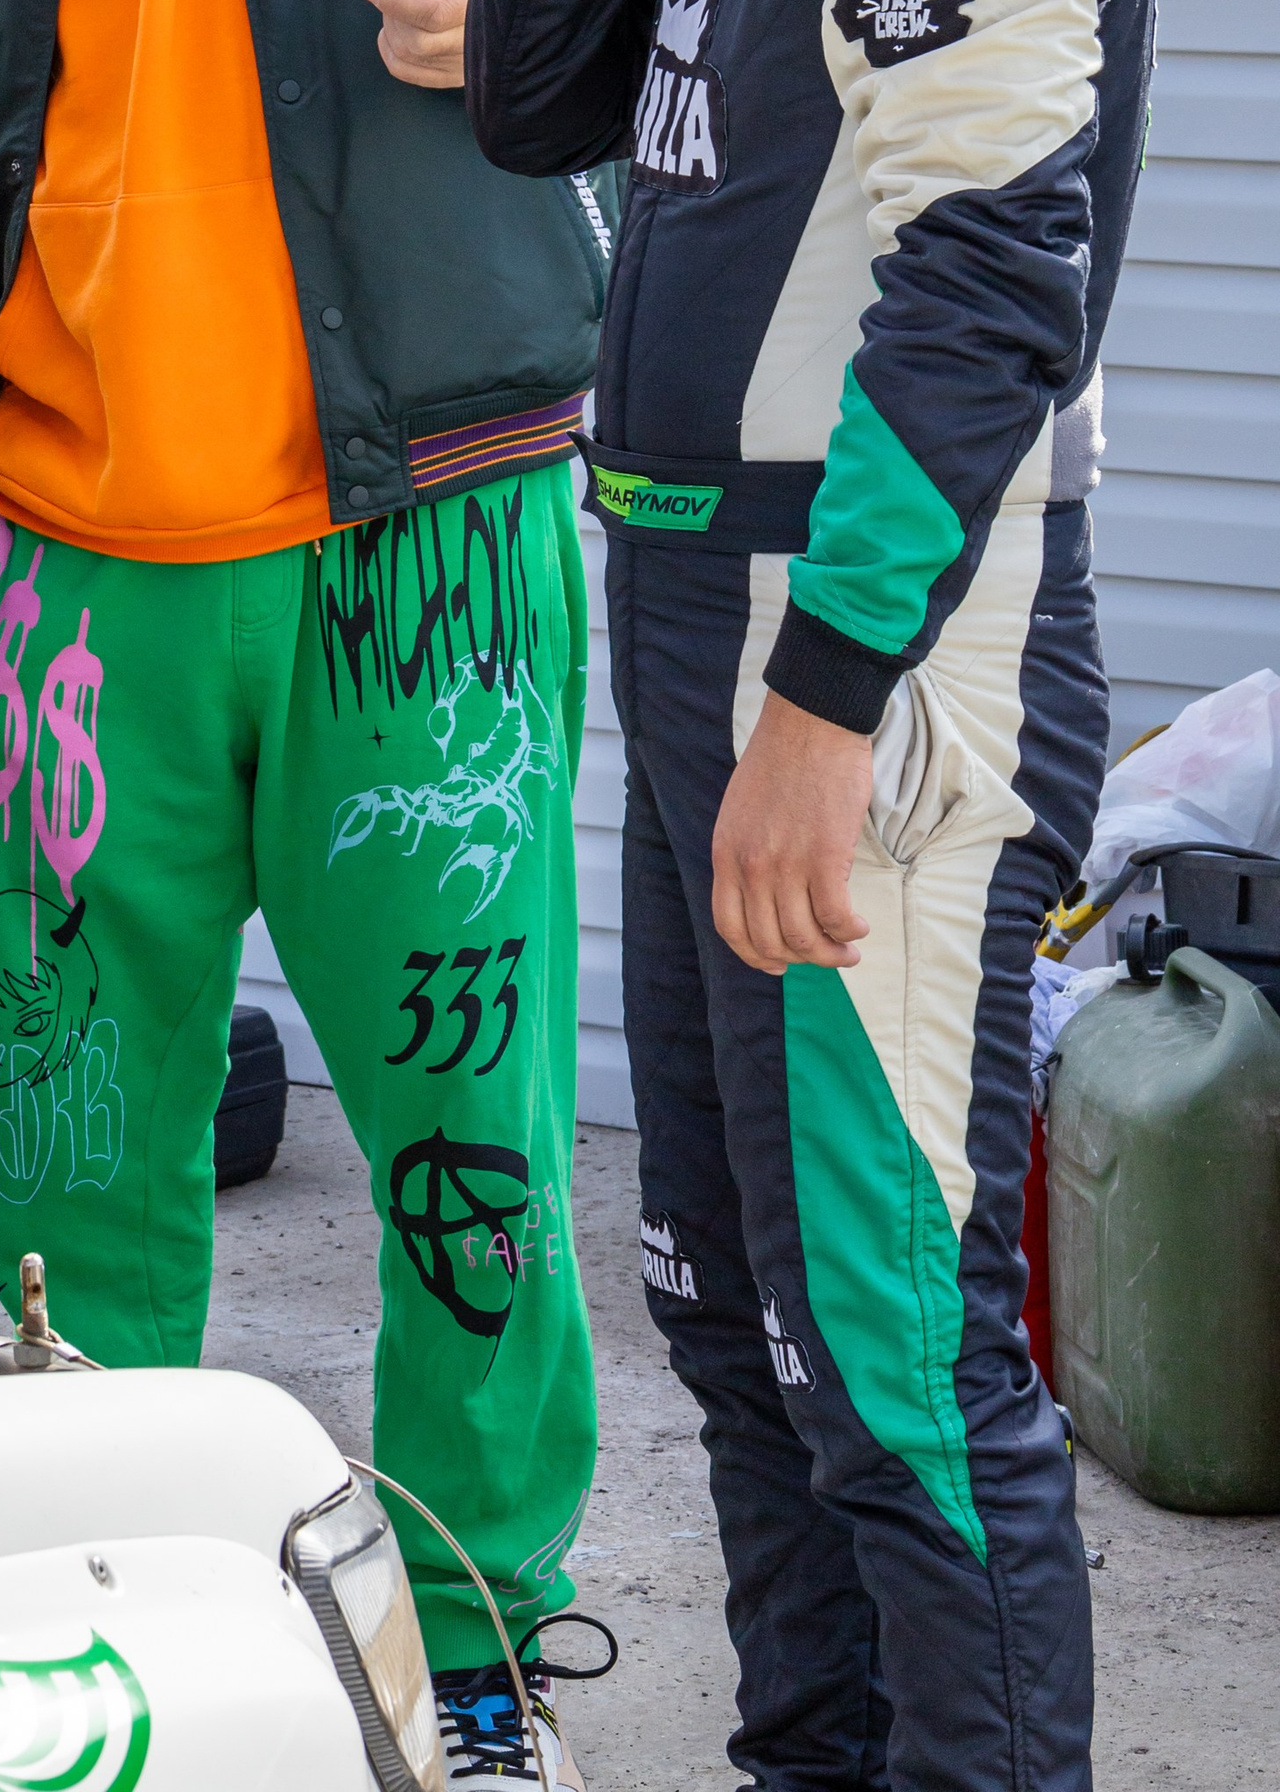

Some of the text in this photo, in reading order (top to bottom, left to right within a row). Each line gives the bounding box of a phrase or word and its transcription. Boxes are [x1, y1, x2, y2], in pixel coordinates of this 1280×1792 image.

[874, 8, 931, 40] CREW
[597, 478, 712, 517] SHARYMOV
[384, 933, 527, 1077] 333
